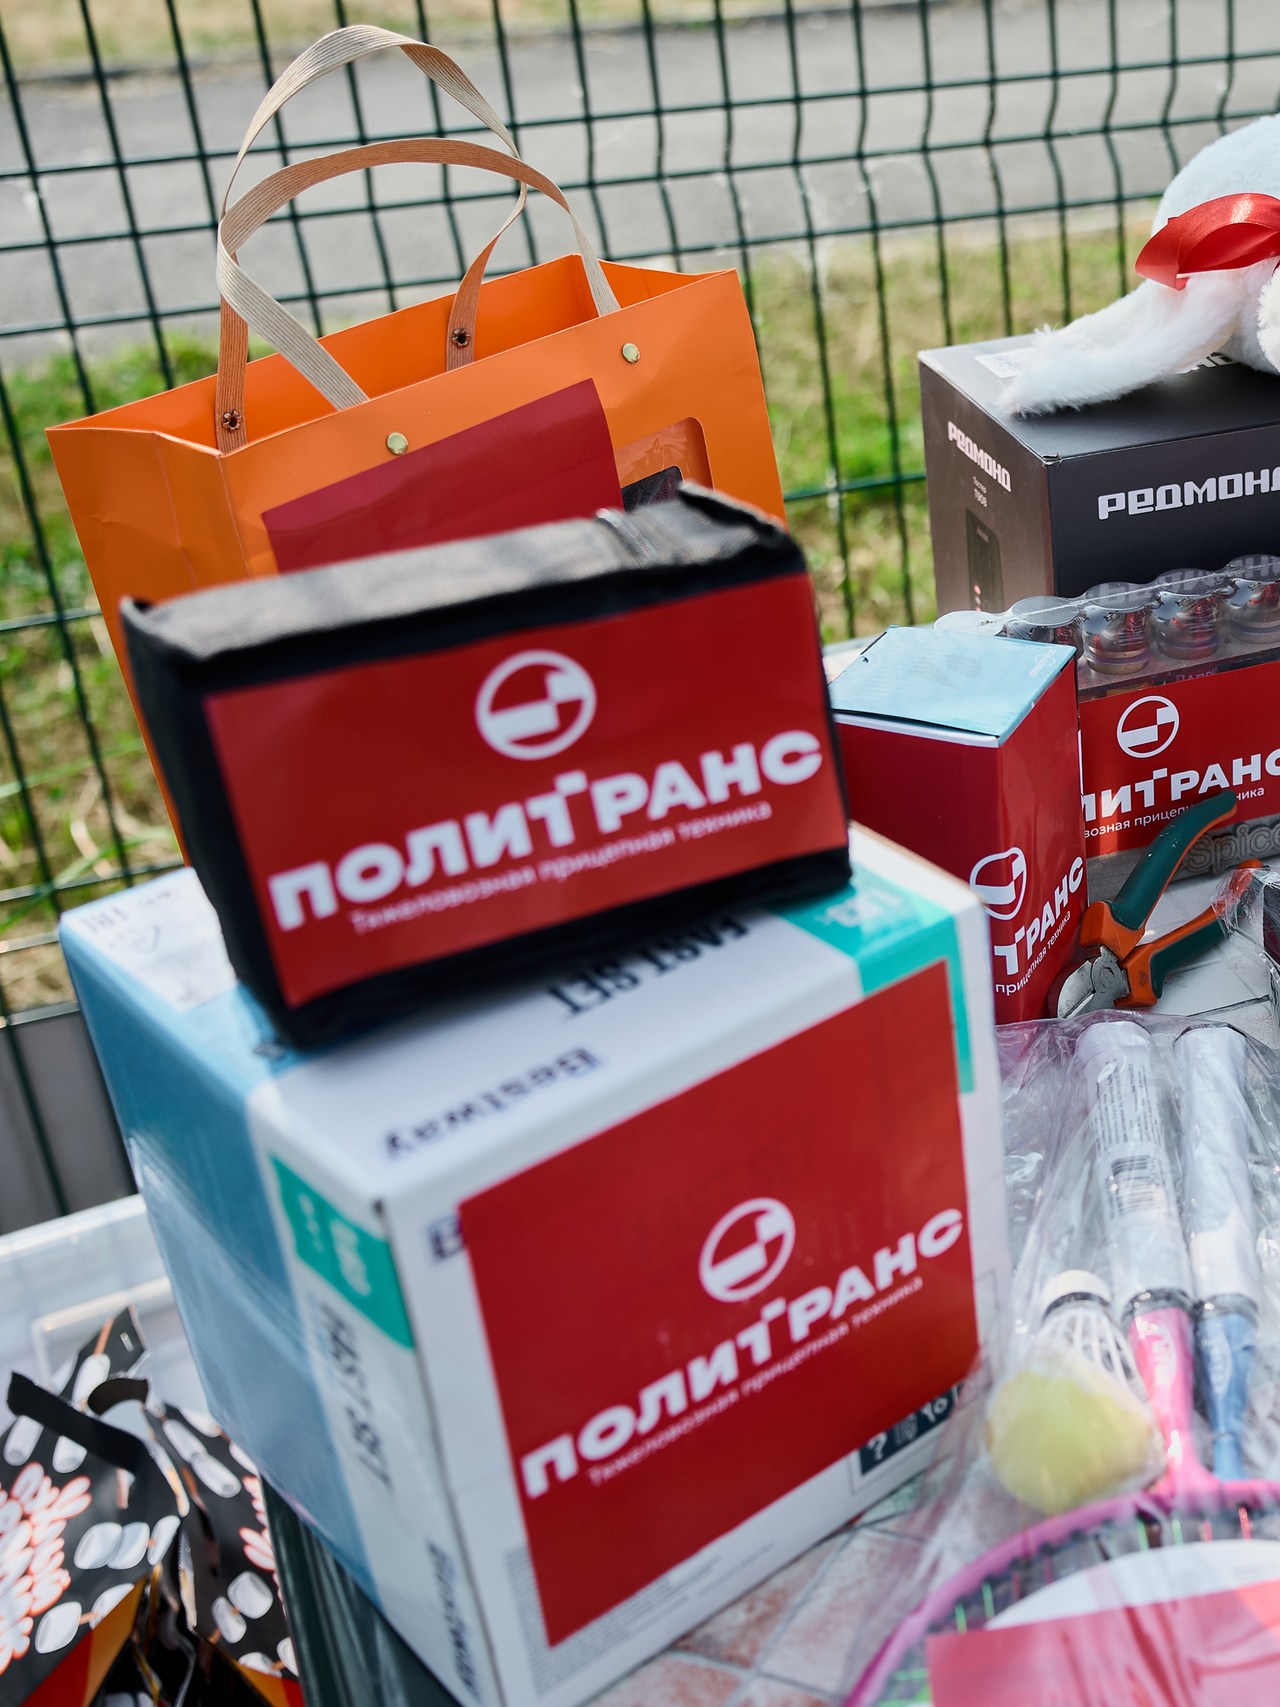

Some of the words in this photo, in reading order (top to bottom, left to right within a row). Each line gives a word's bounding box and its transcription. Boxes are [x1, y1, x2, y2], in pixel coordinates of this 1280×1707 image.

[268, 729, 823, 932] ПОЛИТРАНС
[679, 801, 772, 840] техника
[1084, 820, 1131, 839] возная
[1135, 805, 1192, 828] прицеп
[1236, 786, 1265, 801] ника
[994, 856, 1084, 976] ТРАНС
[995, 946, 1047, 996] прицепная
[1047, 910, 1071, 949] техника
[385, 1046, 600, 1158] Bestway
[519, 1208, 964, 1499] ПОЛИТРАНС
[587, 1387, 740, 1486] Тяжеловозная
[741, 1322, 849, 1397] прицепная
[852, 1275, 924, 1331] техника
